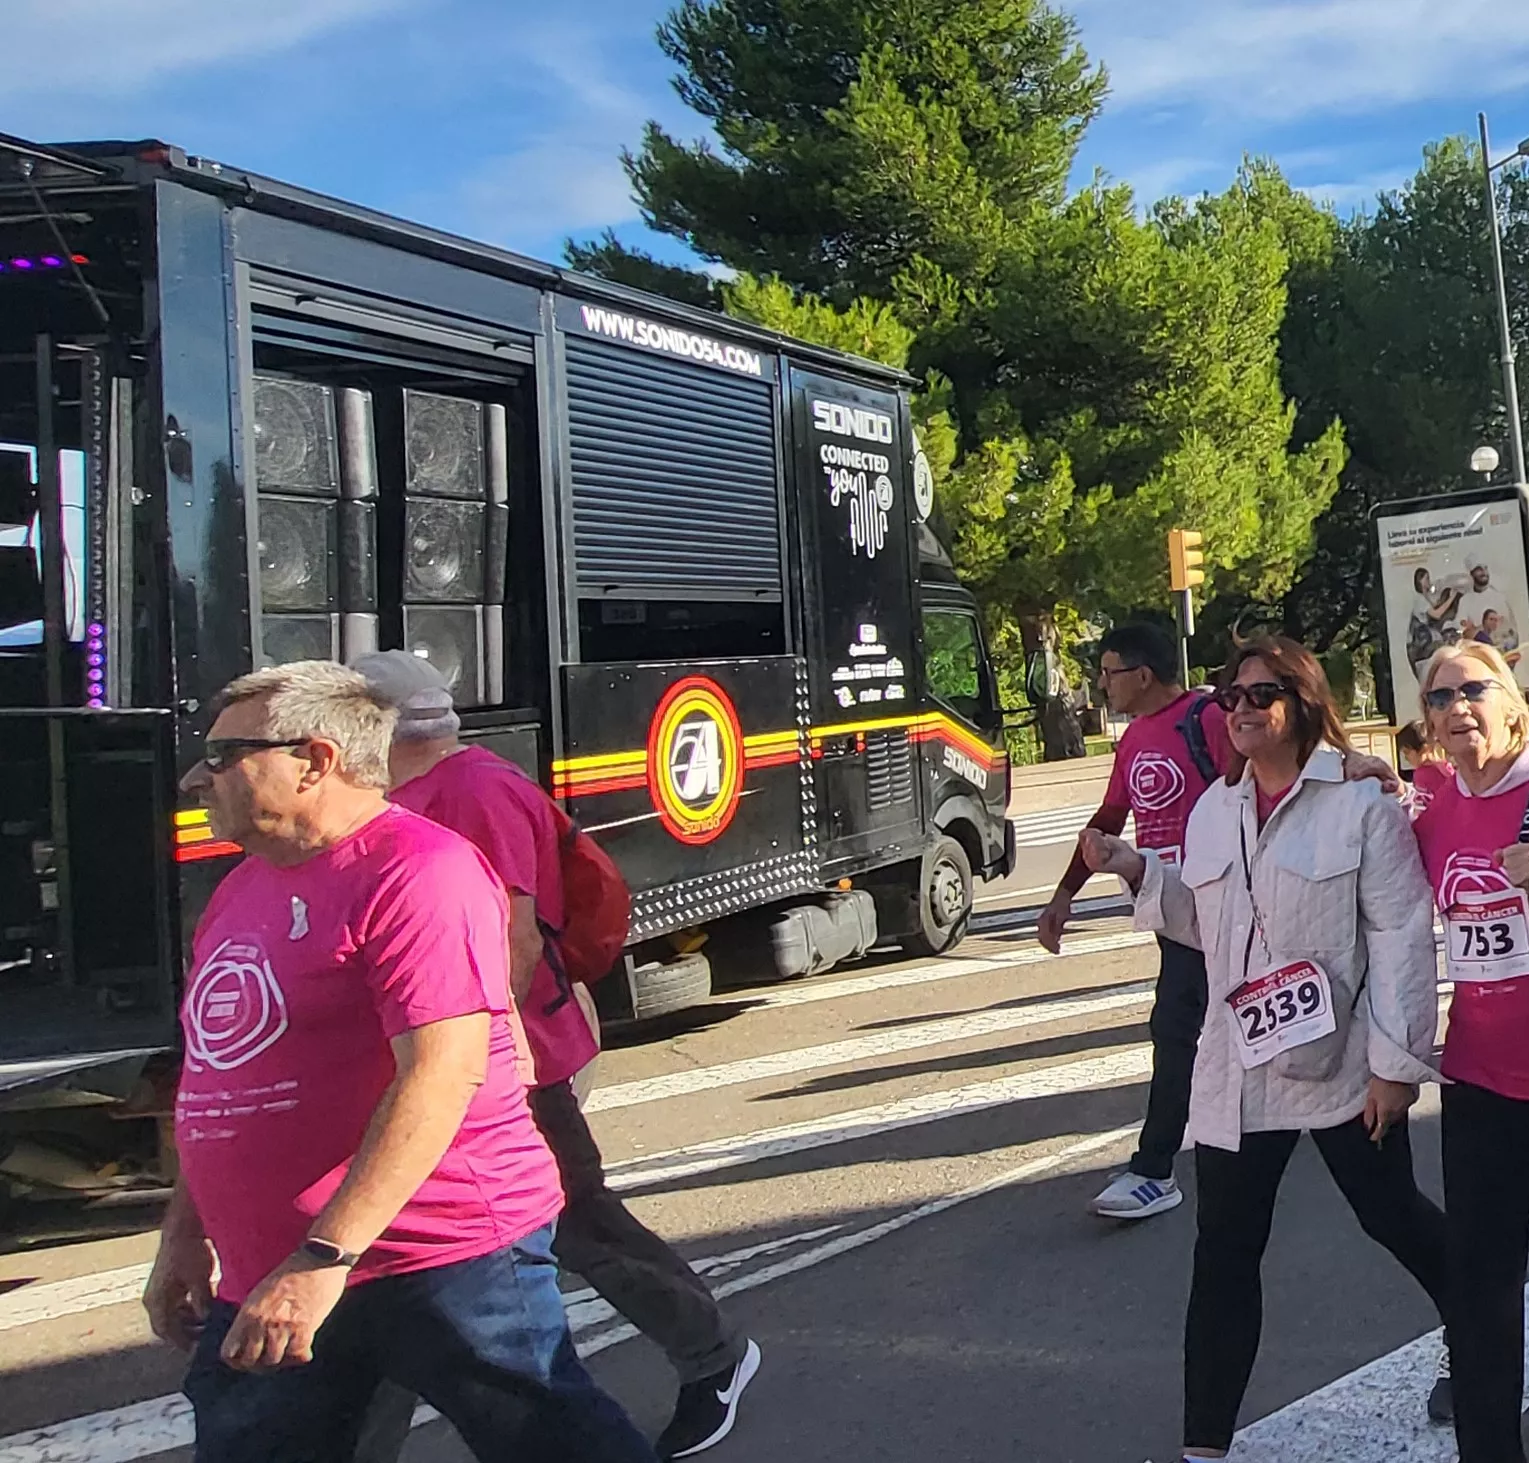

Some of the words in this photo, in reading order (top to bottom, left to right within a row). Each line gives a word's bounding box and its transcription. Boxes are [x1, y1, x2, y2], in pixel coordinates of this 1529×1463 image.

[580, 305, 761, 376] WWW.SONIDO54.COM
[812, 400, 892, 444] SONIDO
[820, 444, 889, 473] CONNECTED
[943, 745, 988, 790] SONIDO
[1459, 923, 1514, 957] 753
[1240, 981, 1320, 1040] 2539
